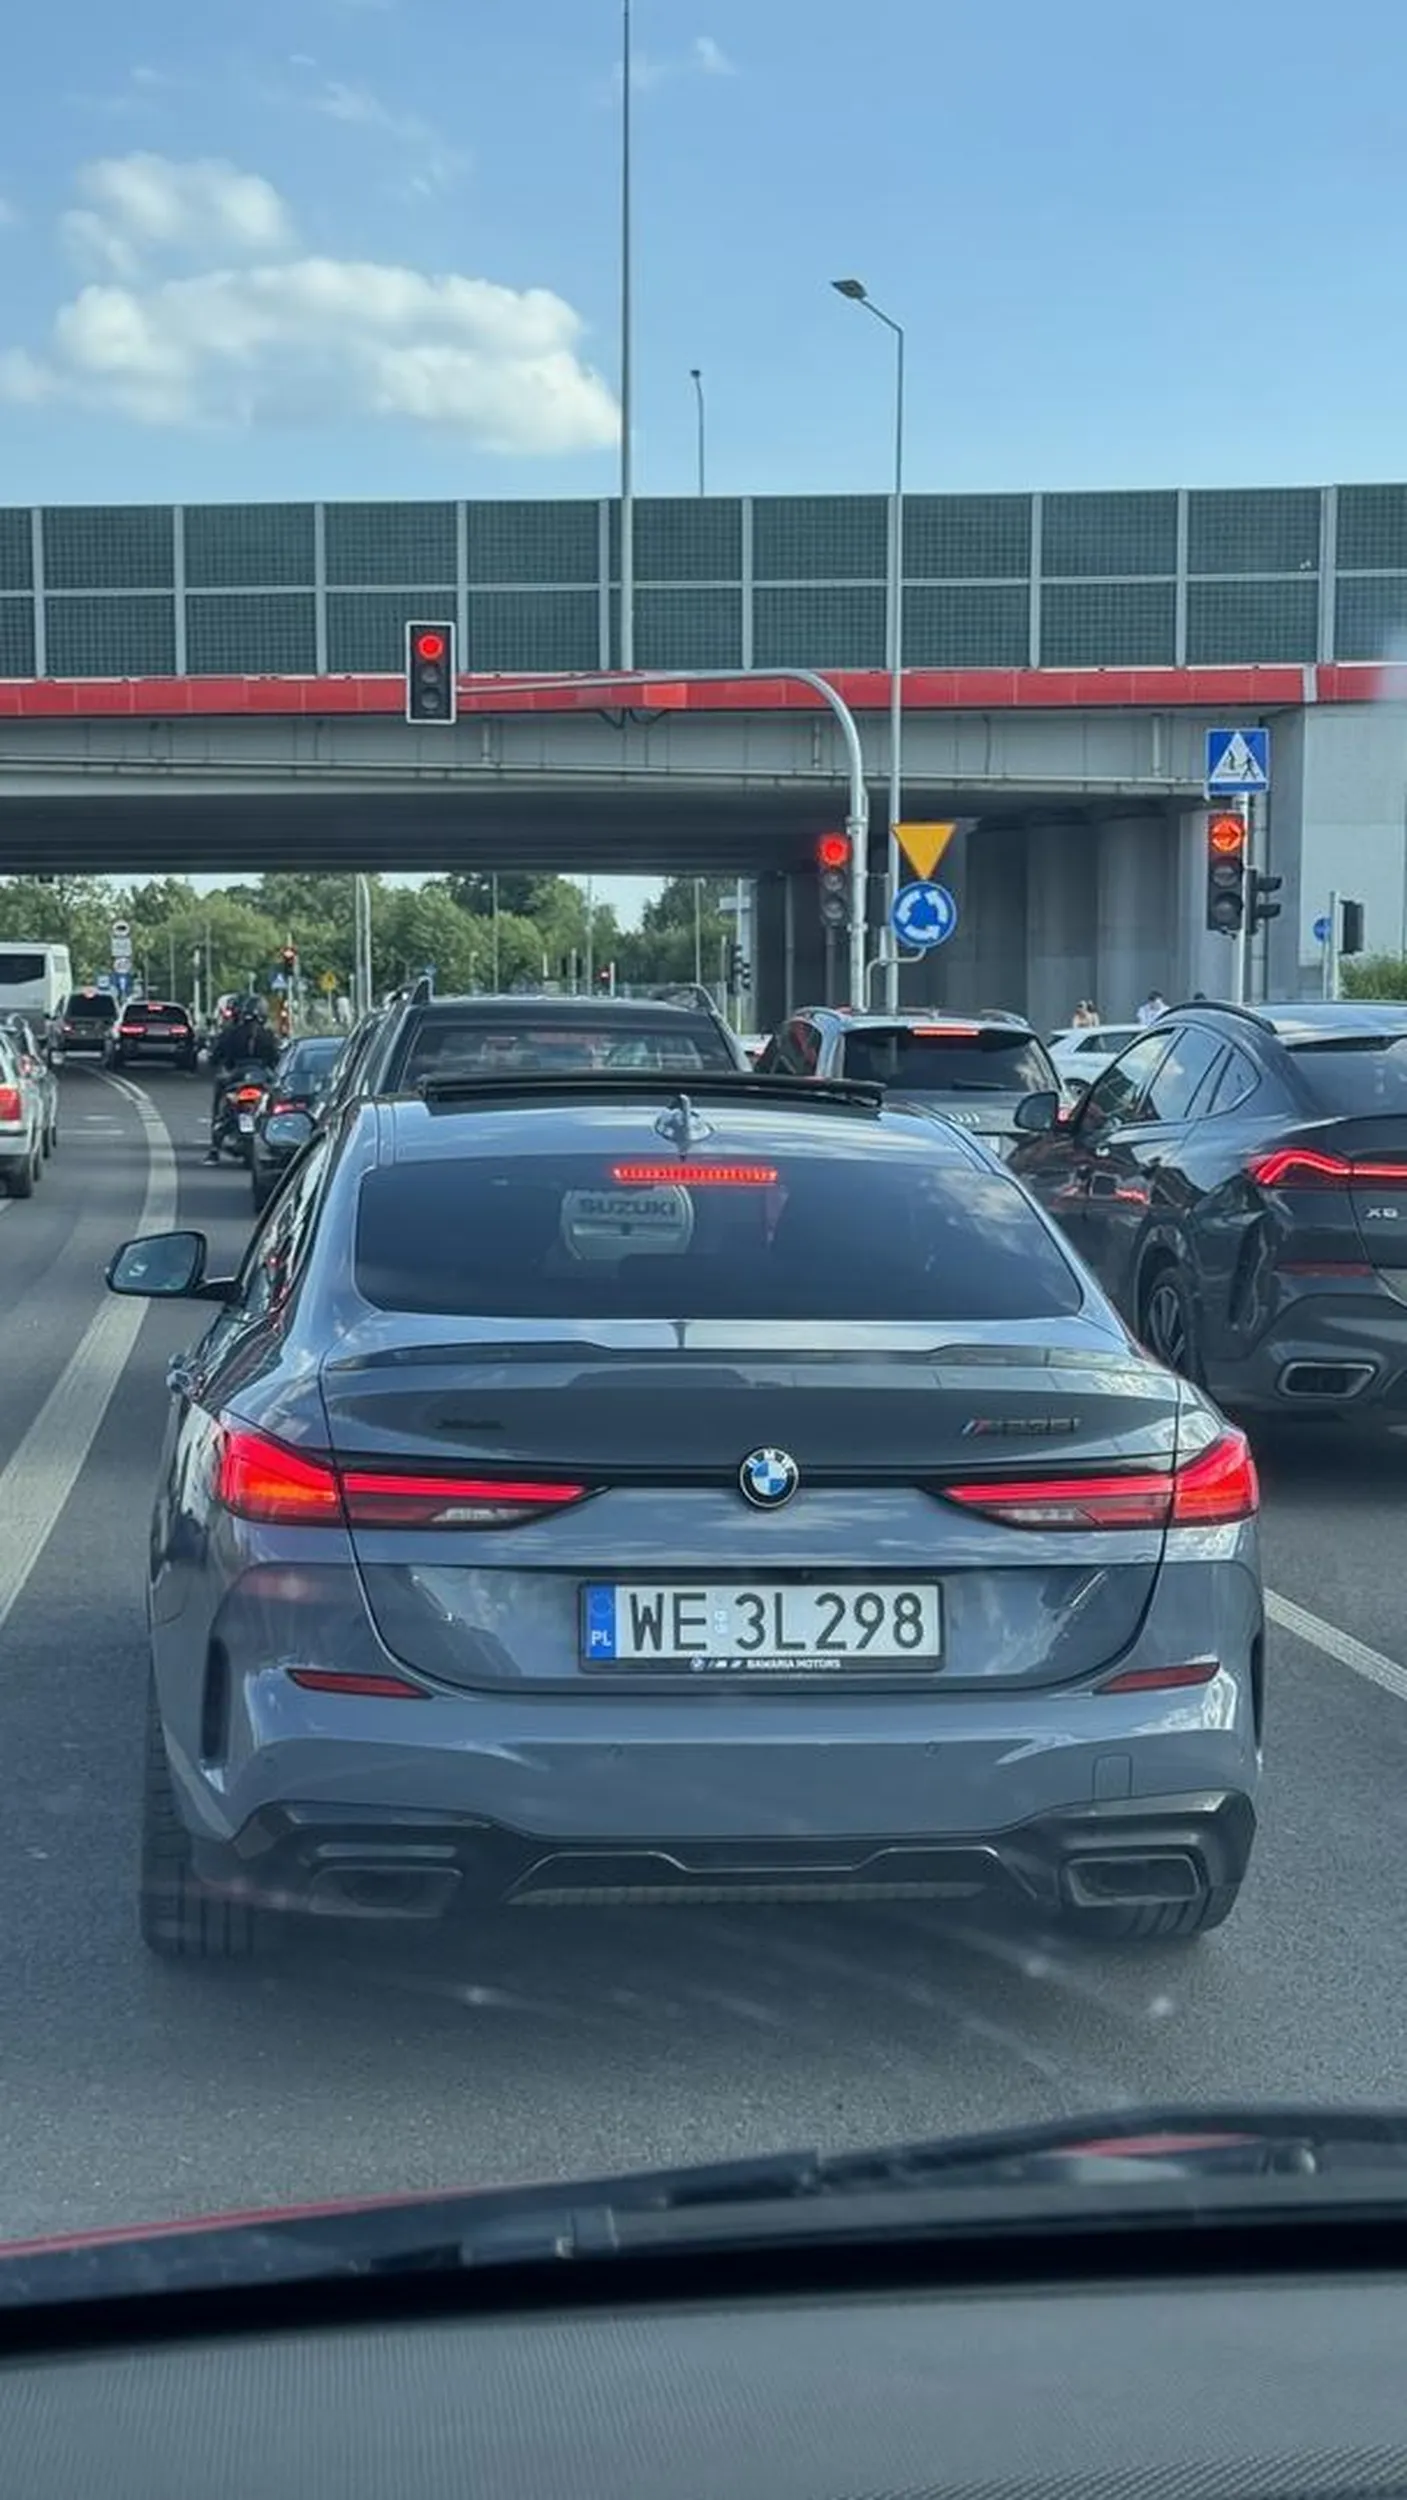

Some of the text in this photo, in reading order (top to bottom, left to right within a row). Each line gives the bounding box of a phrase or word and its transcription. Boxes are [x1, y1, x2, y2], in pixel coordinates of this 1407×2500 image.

[580, 1199, 677, 1217] SUZUKI
[629, 1592, 924, 1651] WE 3L298
[591, 1631, 612, 1646] PL
[796, 1659, 841, 1669] MOTORS
